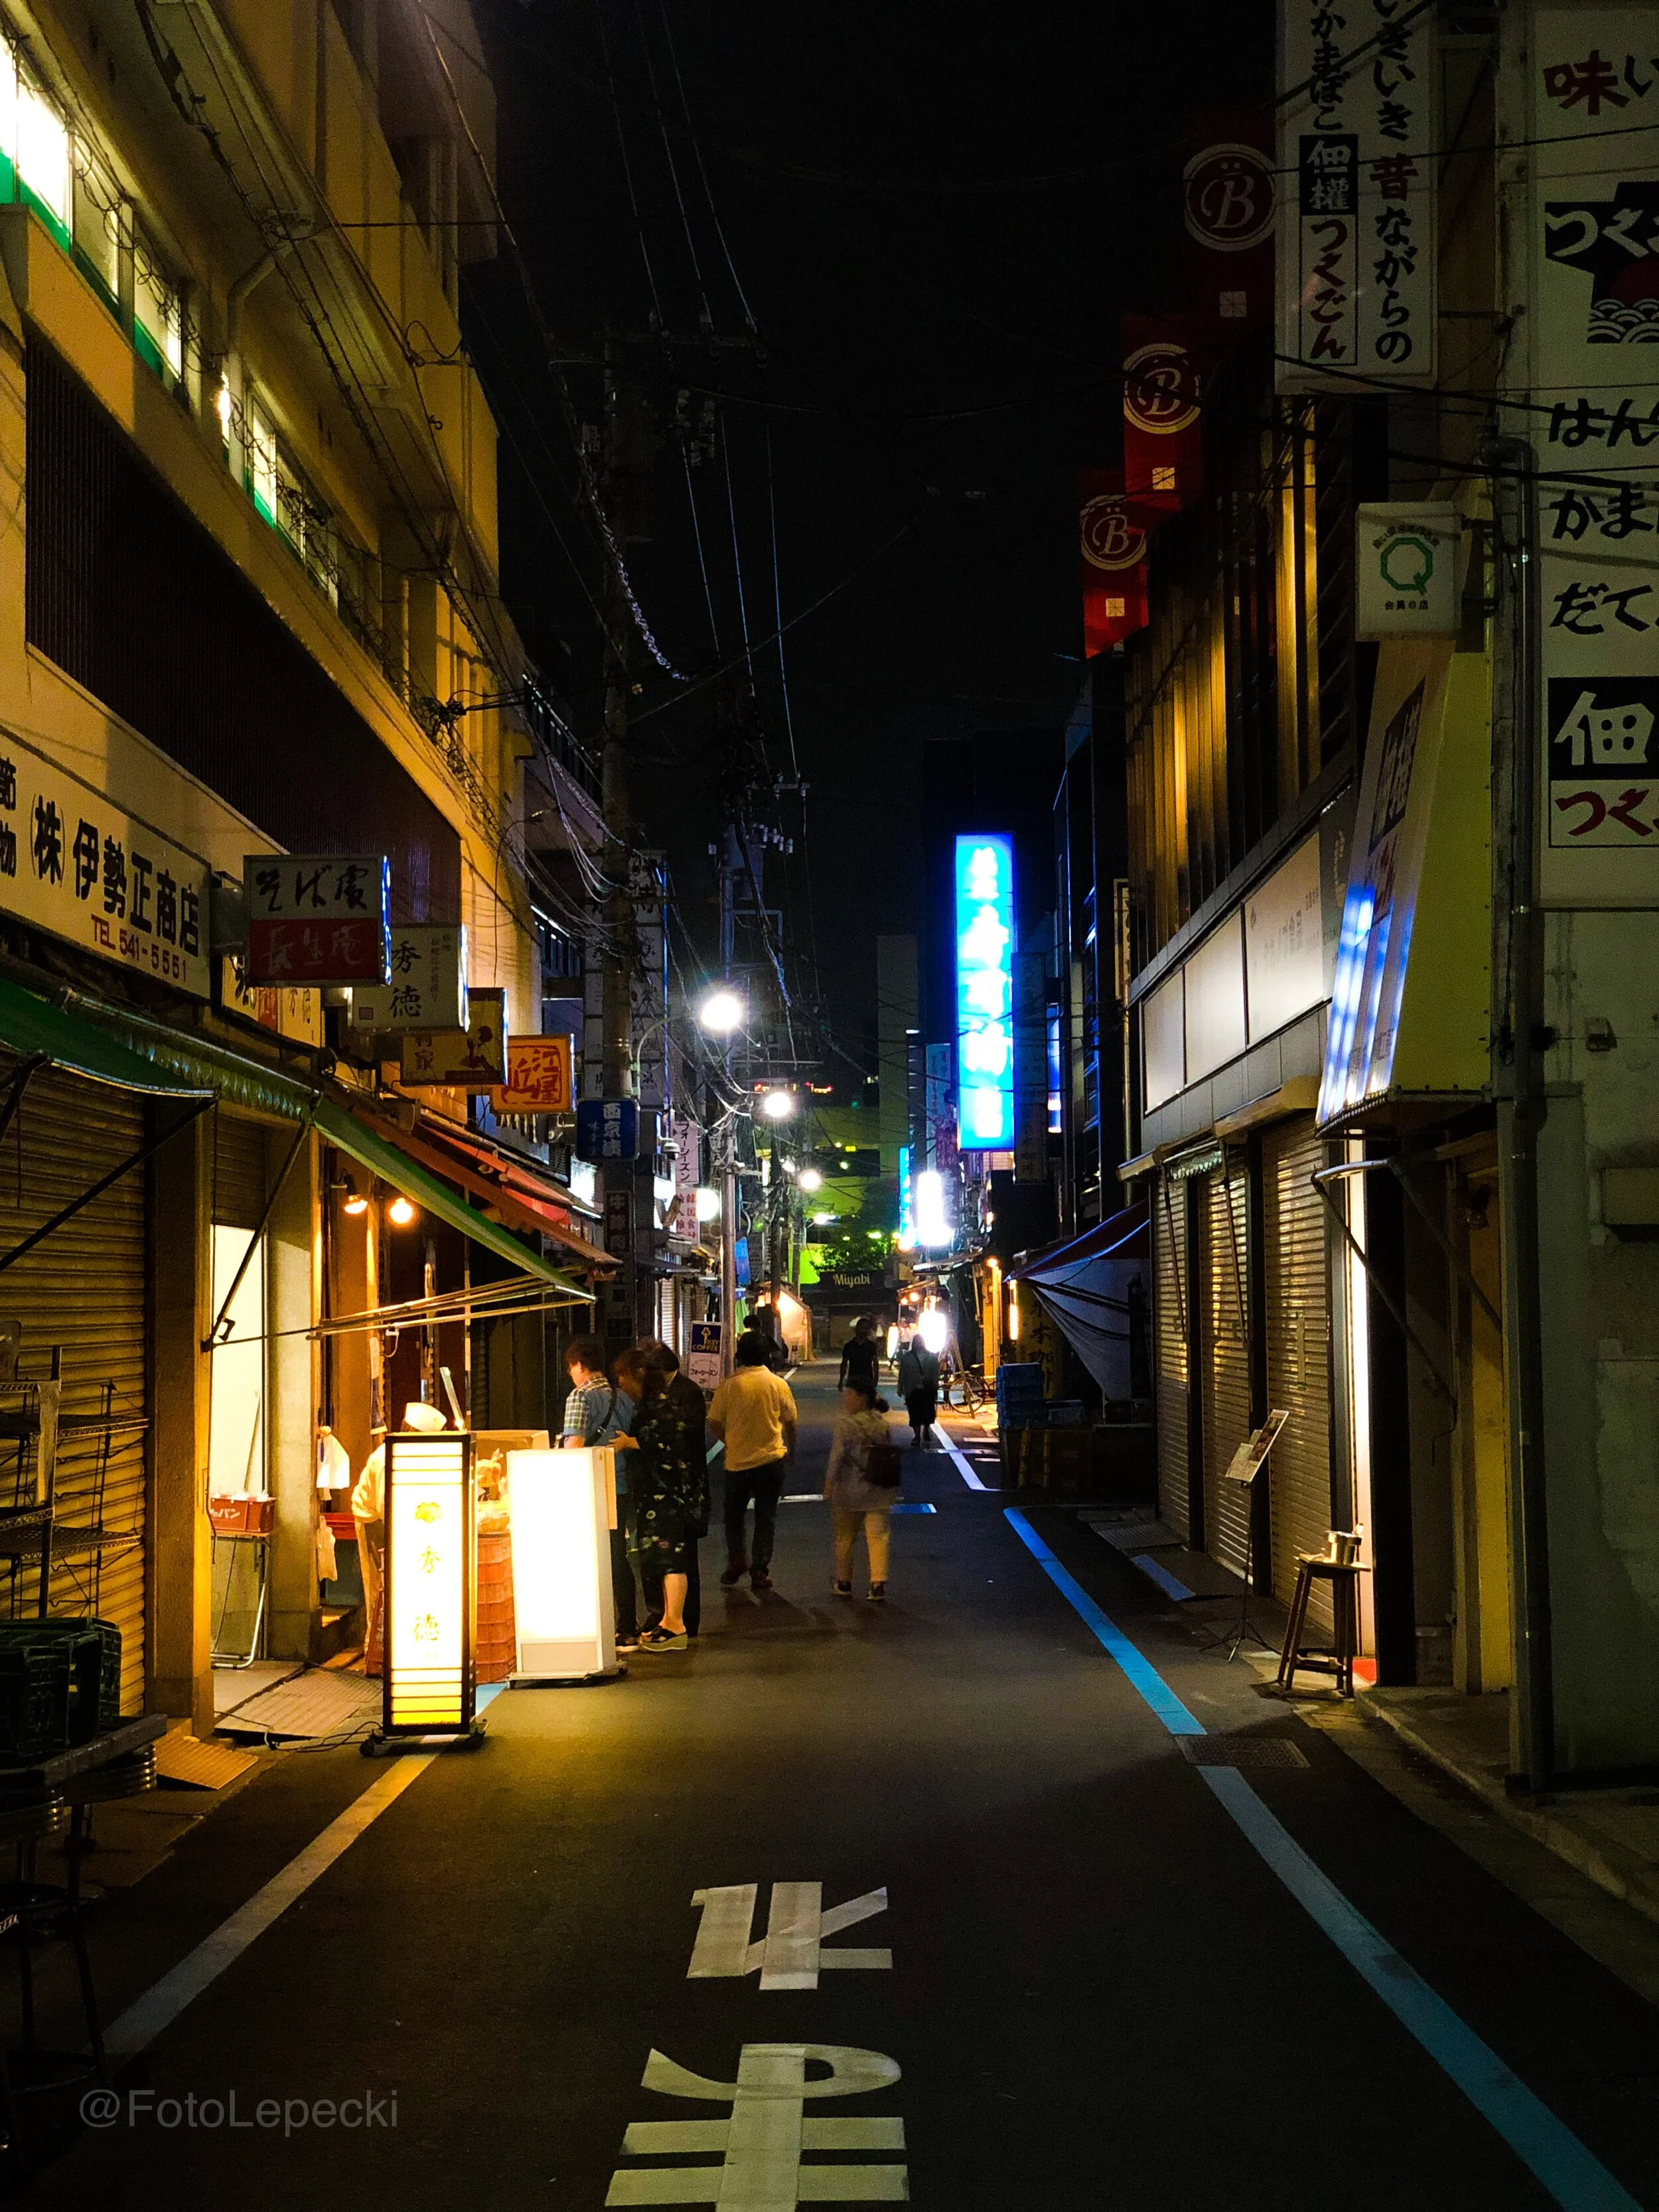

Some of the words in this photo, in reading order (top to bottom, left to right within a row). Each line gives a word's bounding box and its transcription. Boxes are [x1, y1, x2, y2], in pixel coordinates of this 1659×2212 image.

[1309, 0, 1350, 131] かまぼこ
[1545, 207, 1659, 259] つく
[1310, 218, 1348, 360] つくごん
[1548, 398, 1659, 447] はん
[1549, 488, 1659, 541] かま
[1549, 582, 1659, 635] だて
[1555, 788, 1659, 837] つく
[91, 914, 116, 950] TEL
[832, 1273, 871, 1288] Miyabi
